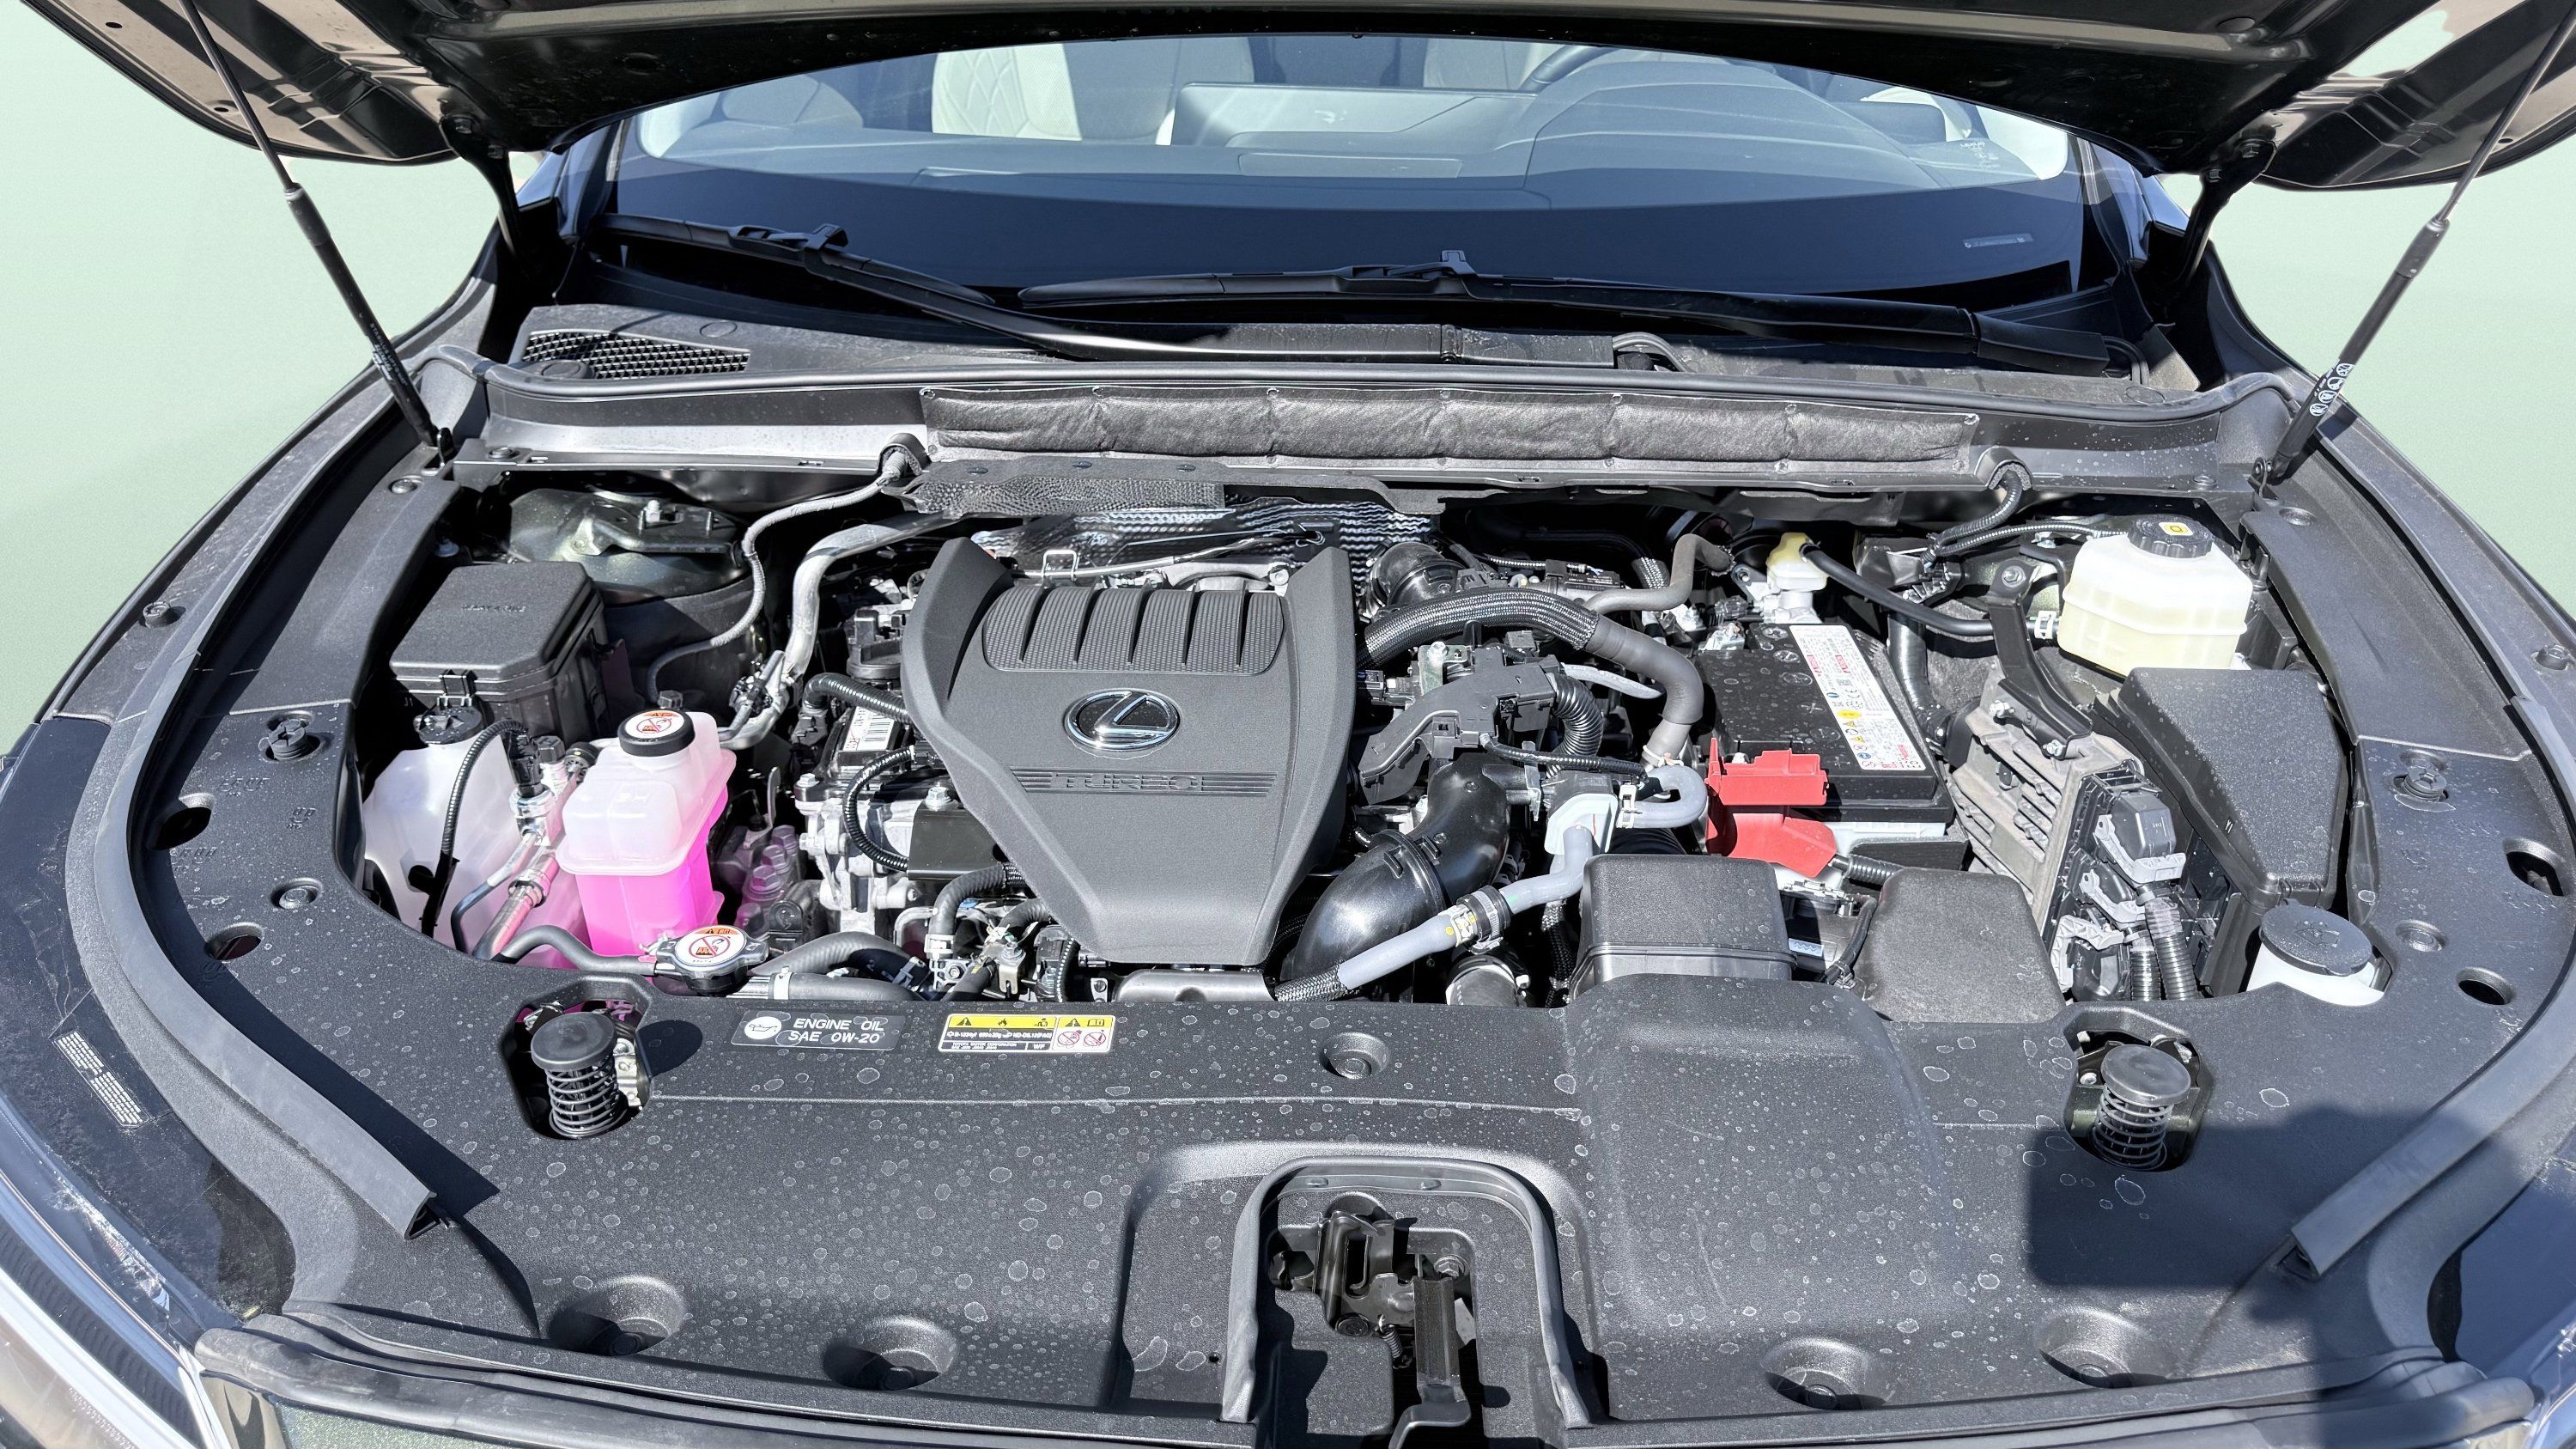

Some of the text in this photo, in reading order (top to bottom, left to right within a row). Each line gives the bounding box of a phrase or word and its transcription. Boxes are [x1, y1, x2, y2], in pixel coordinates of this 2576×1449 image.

[1055, 772, 1198, 790] TURBO
[793, 1018, 885, 1032] ENGINE OIL
[788, 1031, 881, 1044] SAE 0W-20
